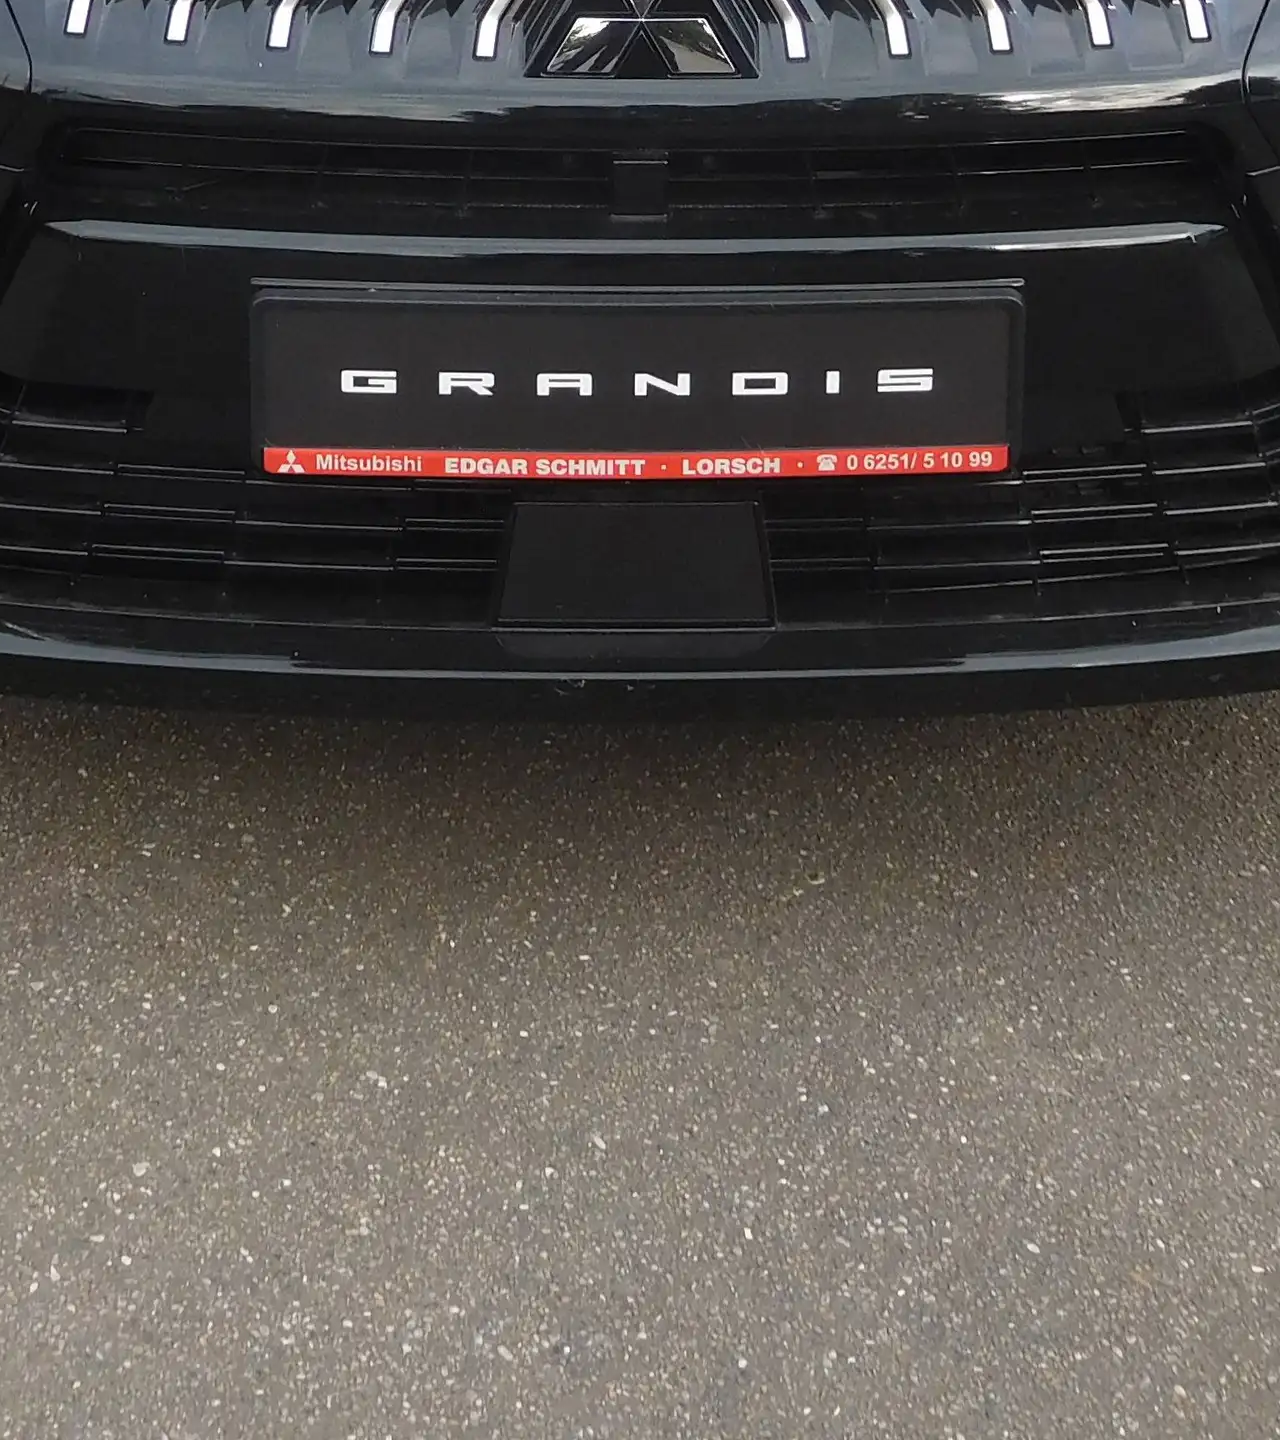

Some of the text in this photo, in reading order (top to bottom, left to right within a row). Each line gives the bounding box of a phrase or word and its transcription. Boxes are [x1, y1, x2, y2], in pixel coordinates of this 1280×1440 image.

[340, 368, 934, 396] GRANDIS
[315, 451, 993, 476] Mitsubishi EDGAR SCHMITT LORSCH 0 6251/ 5 10 99
